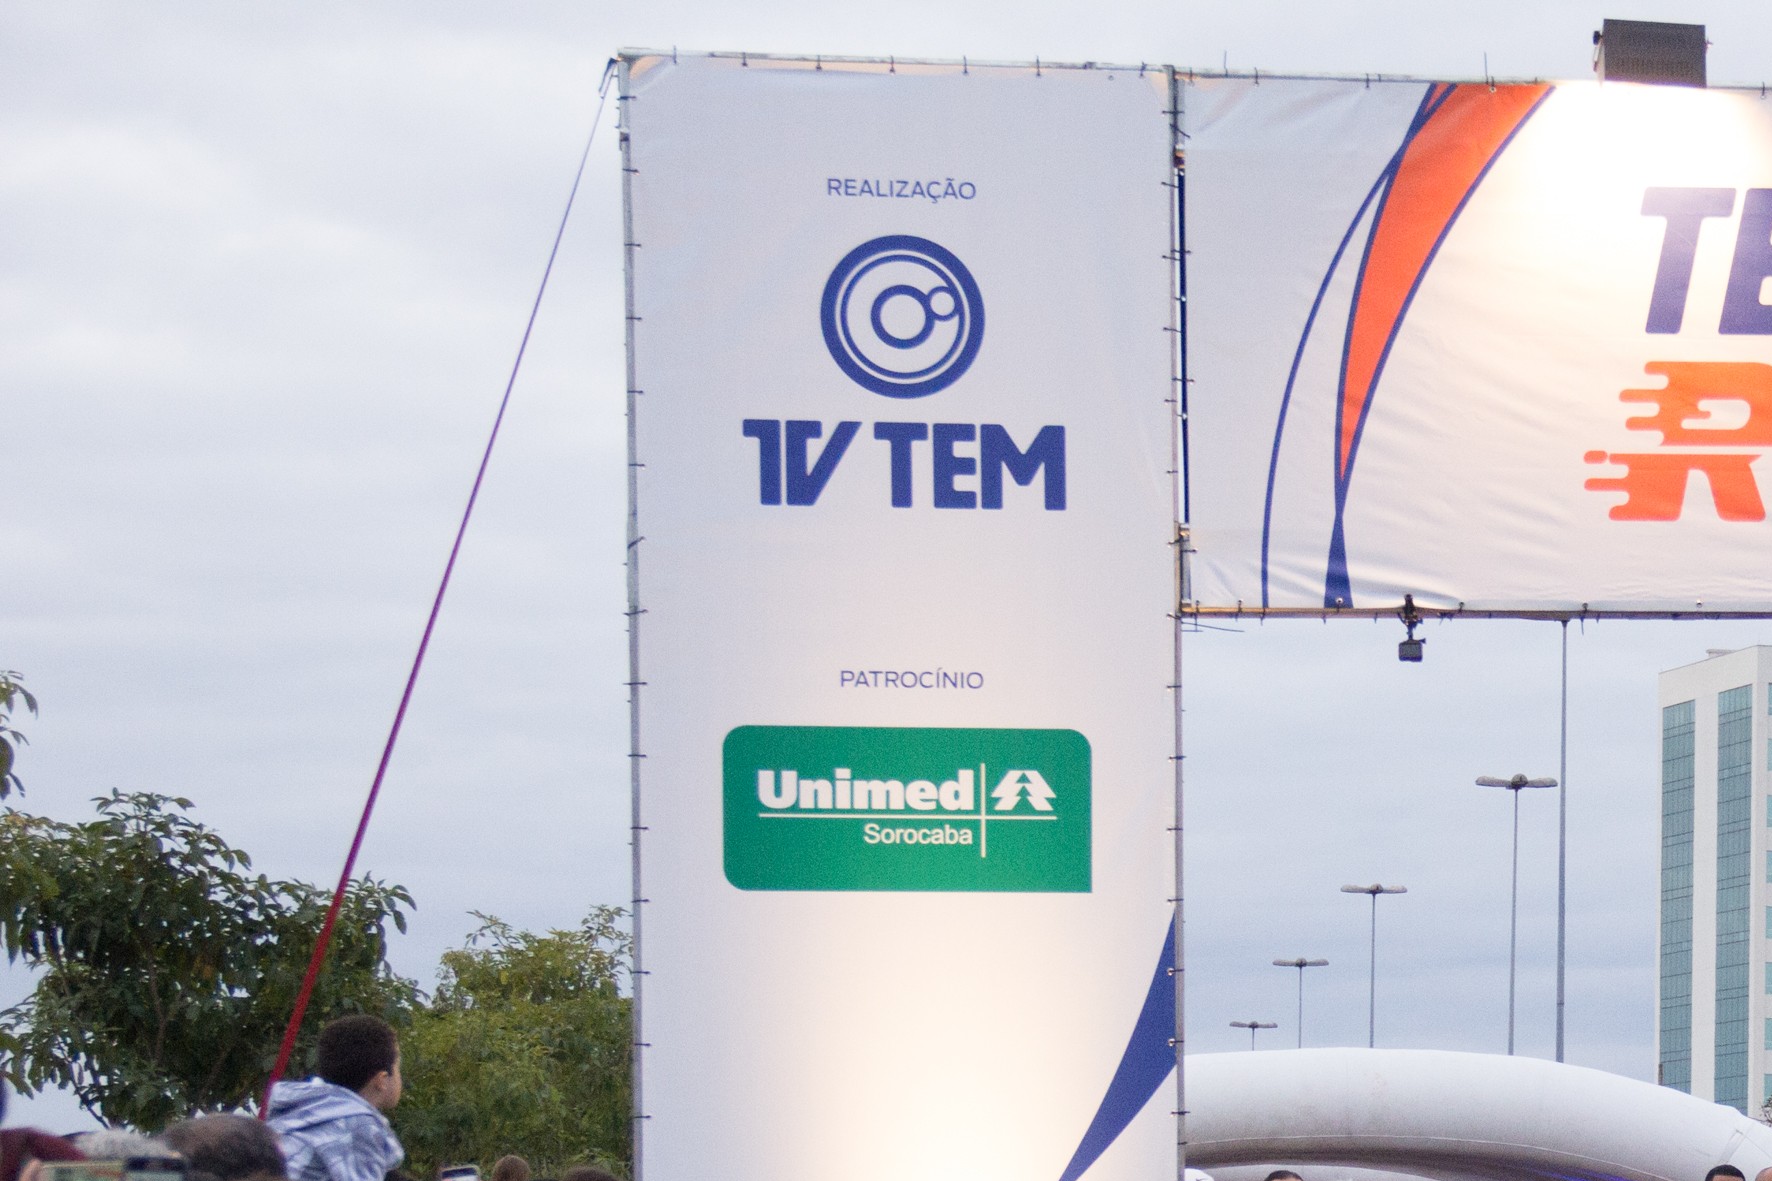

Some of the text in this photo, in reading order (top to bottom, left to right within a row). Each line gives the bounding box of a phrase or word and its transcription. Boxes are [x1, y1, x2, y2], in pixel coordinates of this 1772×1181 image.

[826, 176, 977, 204] REALIZAÇÃO
[742, 417, 1068, 512] TV TEM
[839, 667, 985, 690] PATROCÍNIO
[756, 767, 975, 812] Unimed
[863, 821, 974, 846] Sorocaba
